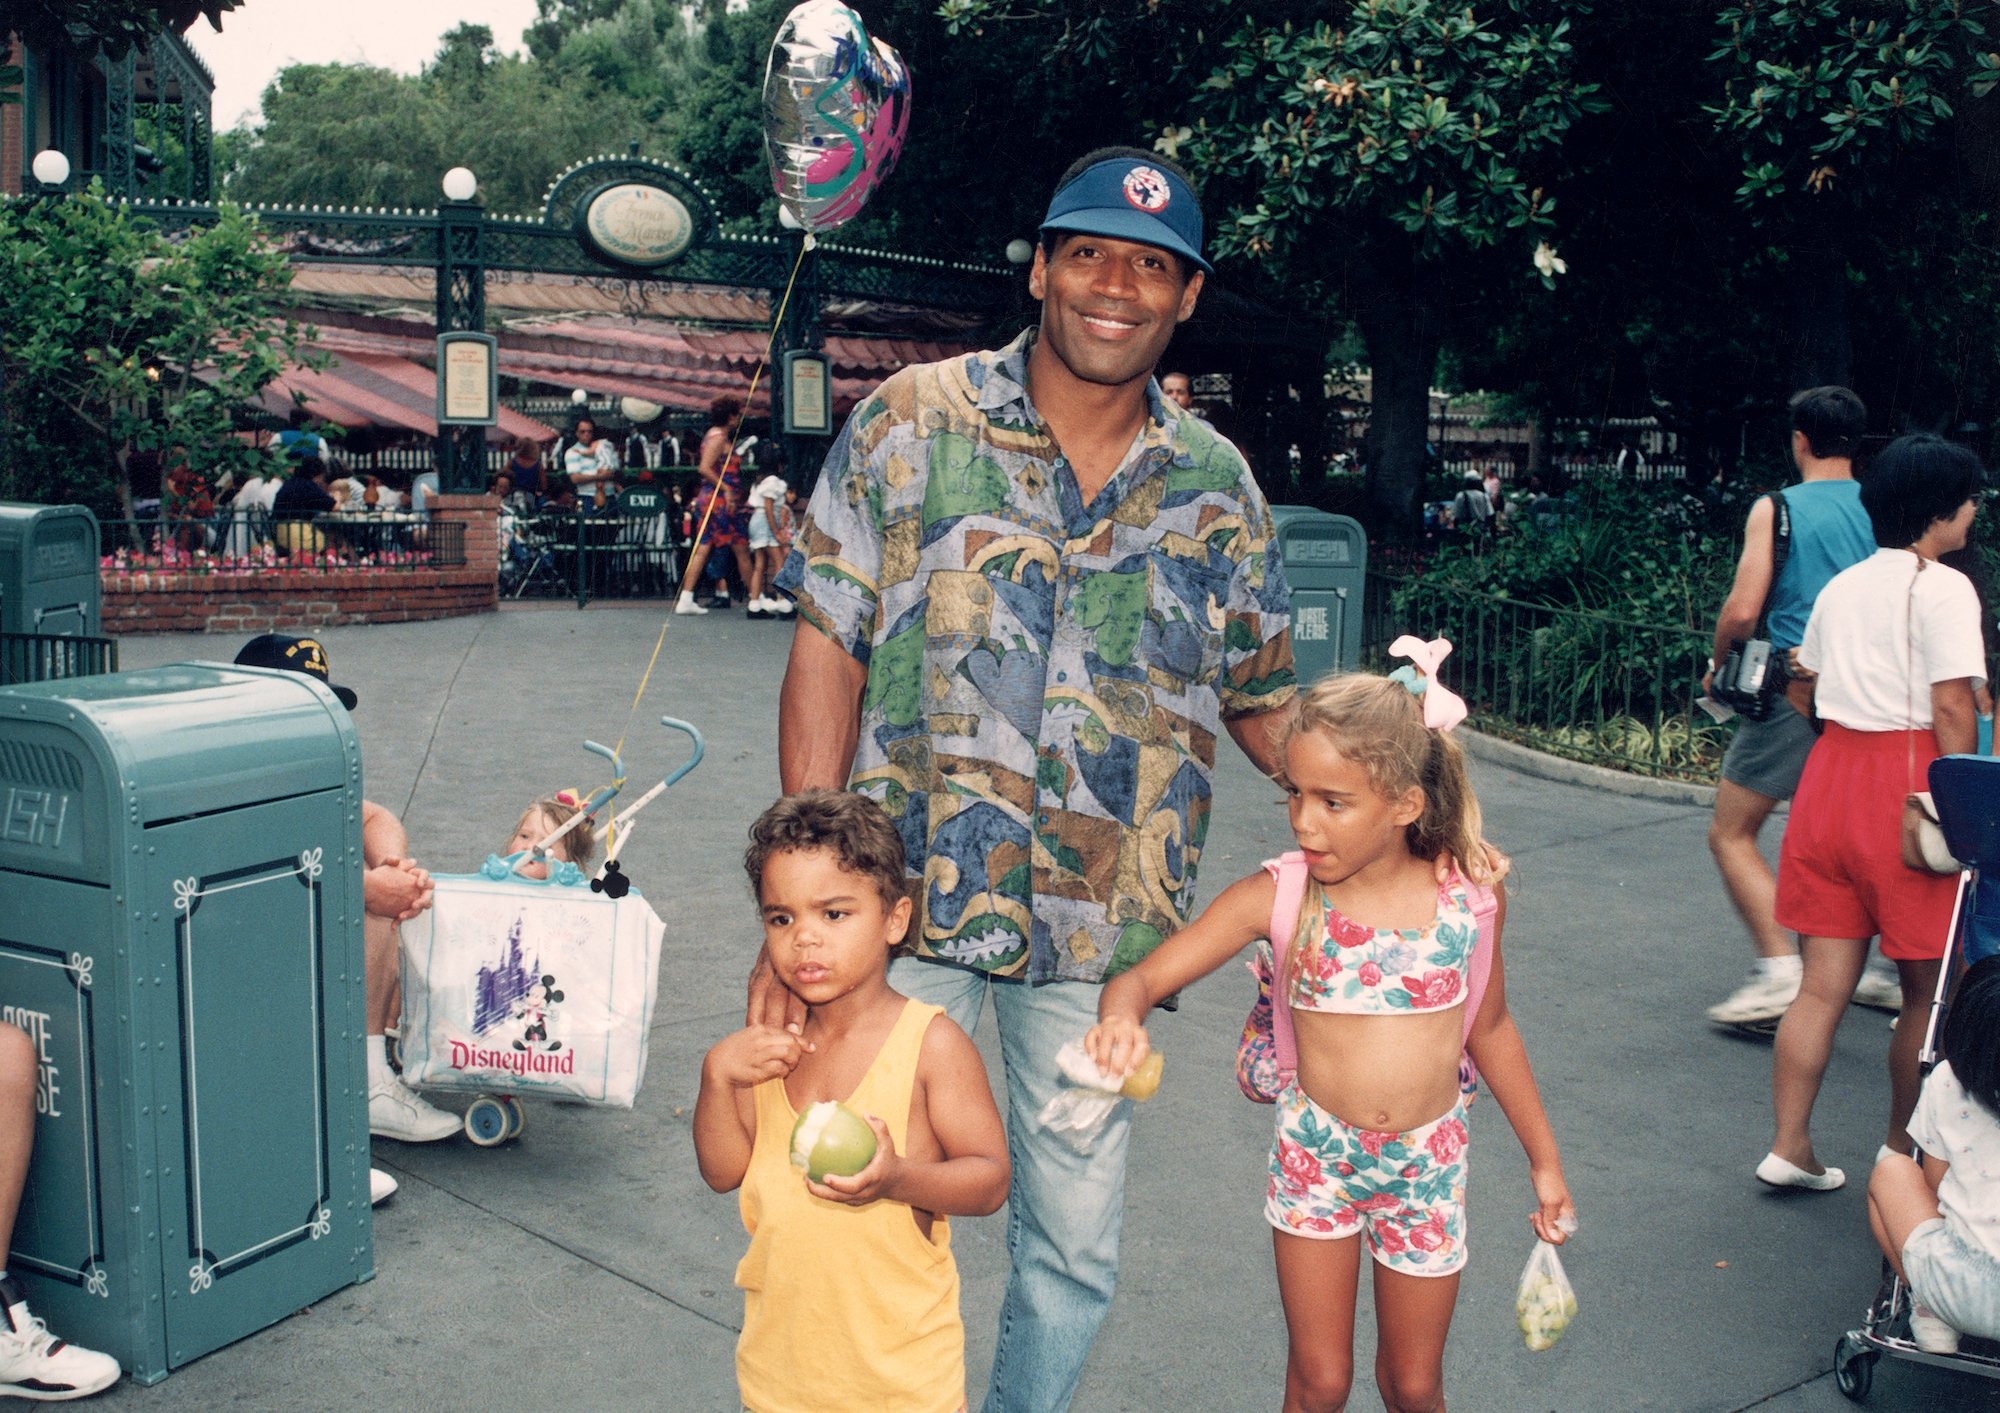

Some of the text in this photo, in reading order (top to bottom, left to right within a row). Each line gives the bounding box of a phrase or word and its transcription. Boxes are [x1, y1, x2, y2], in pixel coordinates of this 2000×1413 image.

[629, 494, 656, 507] EXIT
[1295, 540, 1341, 559] PUSH
[1298, 607, 1328, 624] WASTE
[1295, 624, 1329, 640] PLEASE
[448, 1039, 574, 1076] Disneyland
